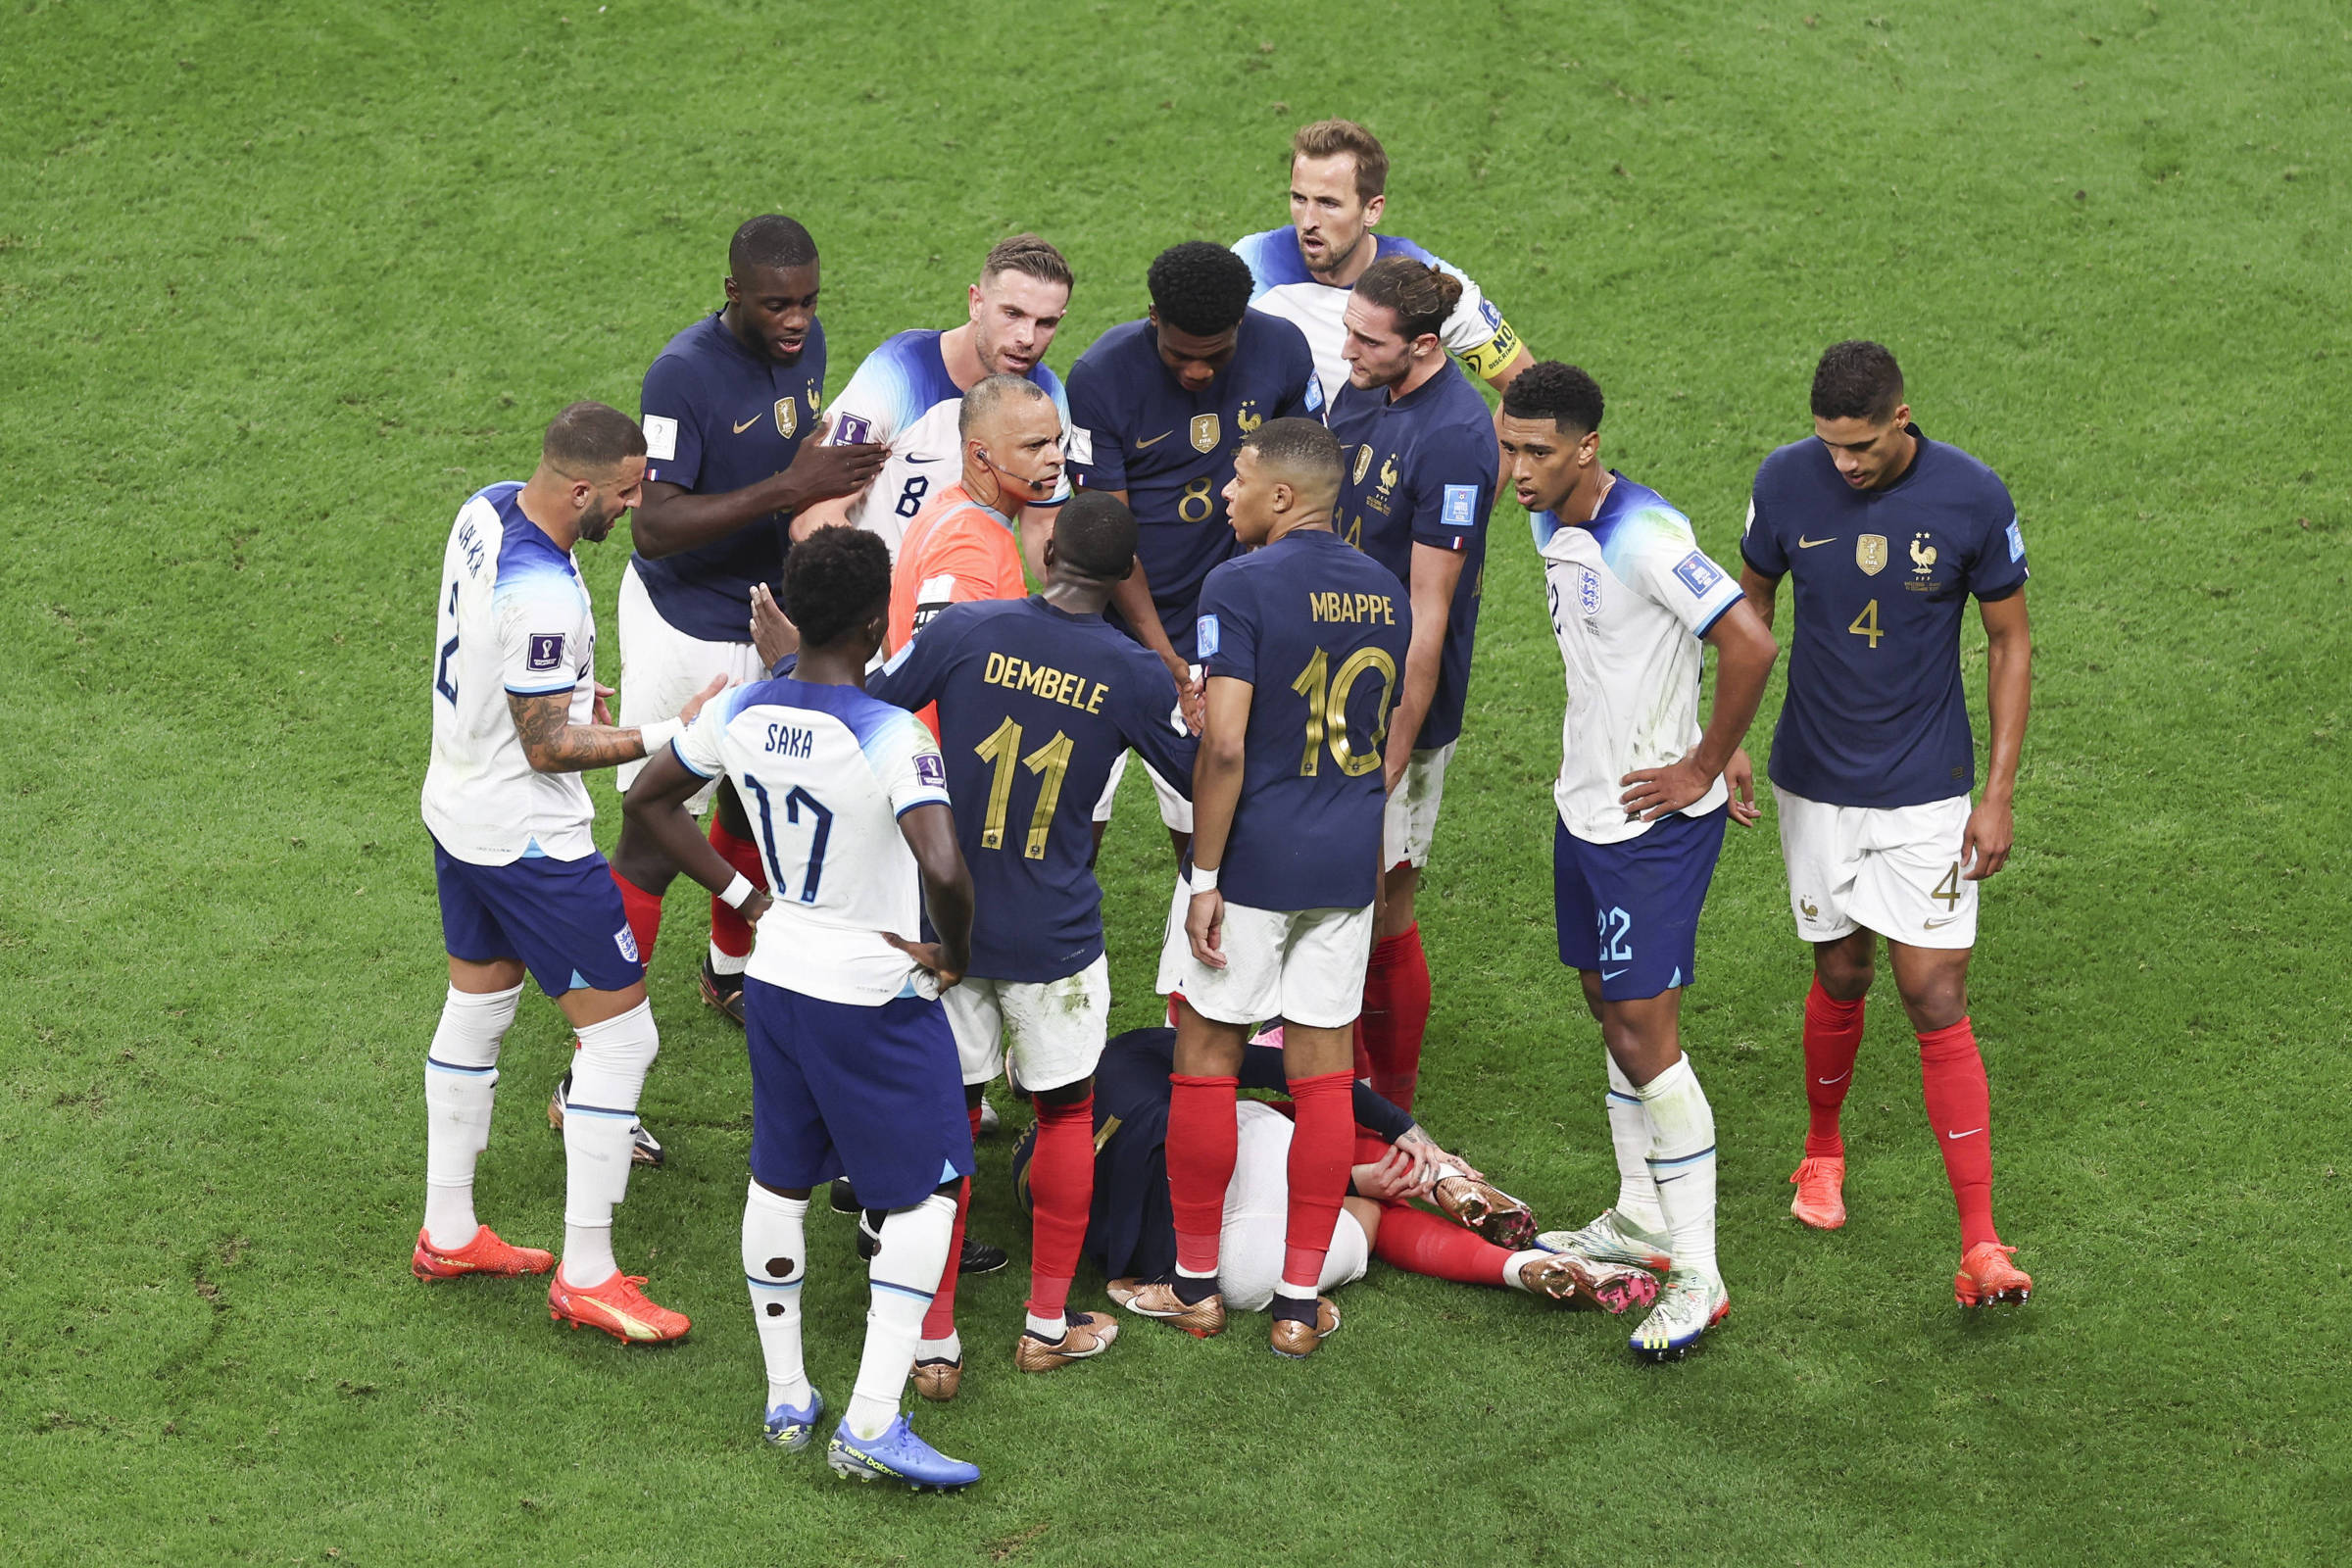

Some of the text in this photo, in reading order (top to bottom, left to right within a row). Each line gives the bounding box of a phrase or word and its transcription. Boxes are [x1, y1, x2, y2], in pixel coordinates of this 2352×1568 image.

[1492, 324, 1513, 354] NO
[895, 475, 929, 518] 8
[1178, 476, 1213, 522] 8
[1309, 592, 1396, 625] MBAPPE
[1848, 599, 1885, 648] 4
[983, 652, 1110, 715] DEMBELE
[1291, 644, 1396, 776] 10
[765, 723, 812, 760] SAKA
[973, 714, 1075, 860] 11
[744, 772, 833, 903] 17
[1931, 861, 1961, 912] 4
[1597, 906, 1633, 961] 22
[844, 1444, 866, 1460] new
